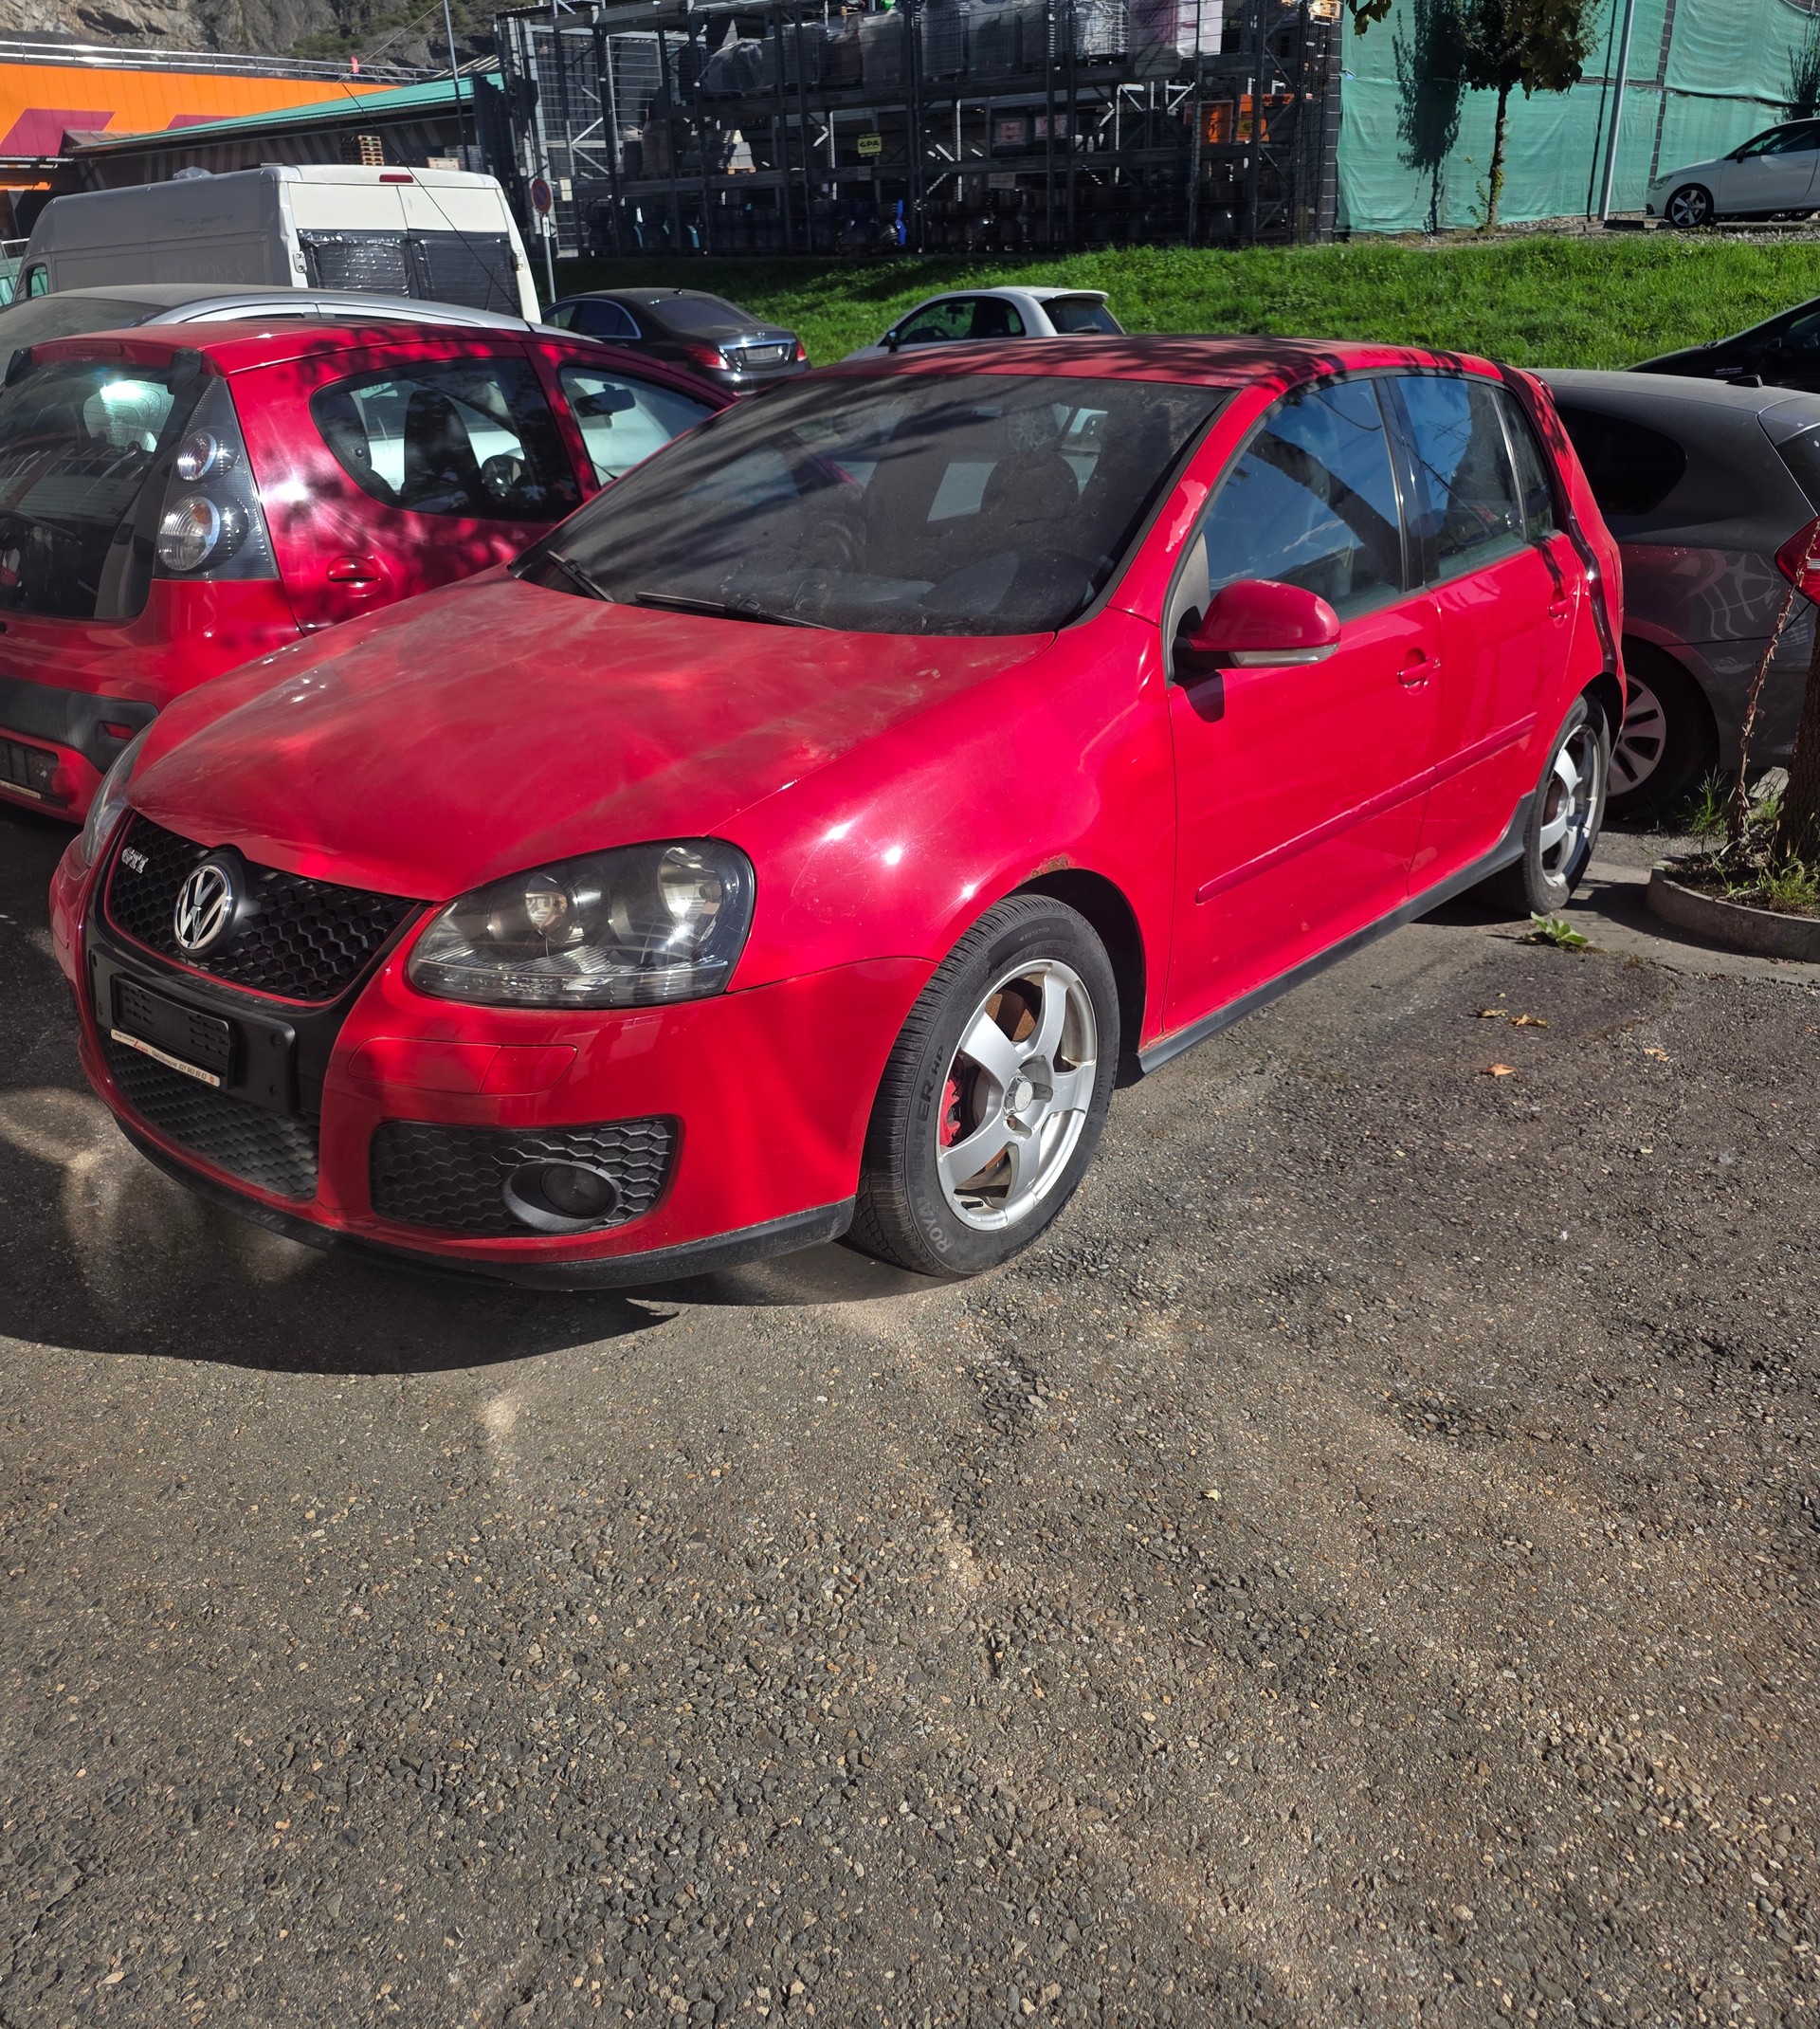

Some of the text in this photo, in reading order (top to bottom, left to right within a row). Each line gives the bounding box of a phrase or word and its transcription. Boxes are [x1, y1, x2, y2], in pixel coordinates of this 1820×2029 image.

[121, 847, 149, 873] GTI
[174, 865, 231, 949] VW
[931, 1045, 944, 1075] HP
[918, 1197, 953, 1253] ROYAL
